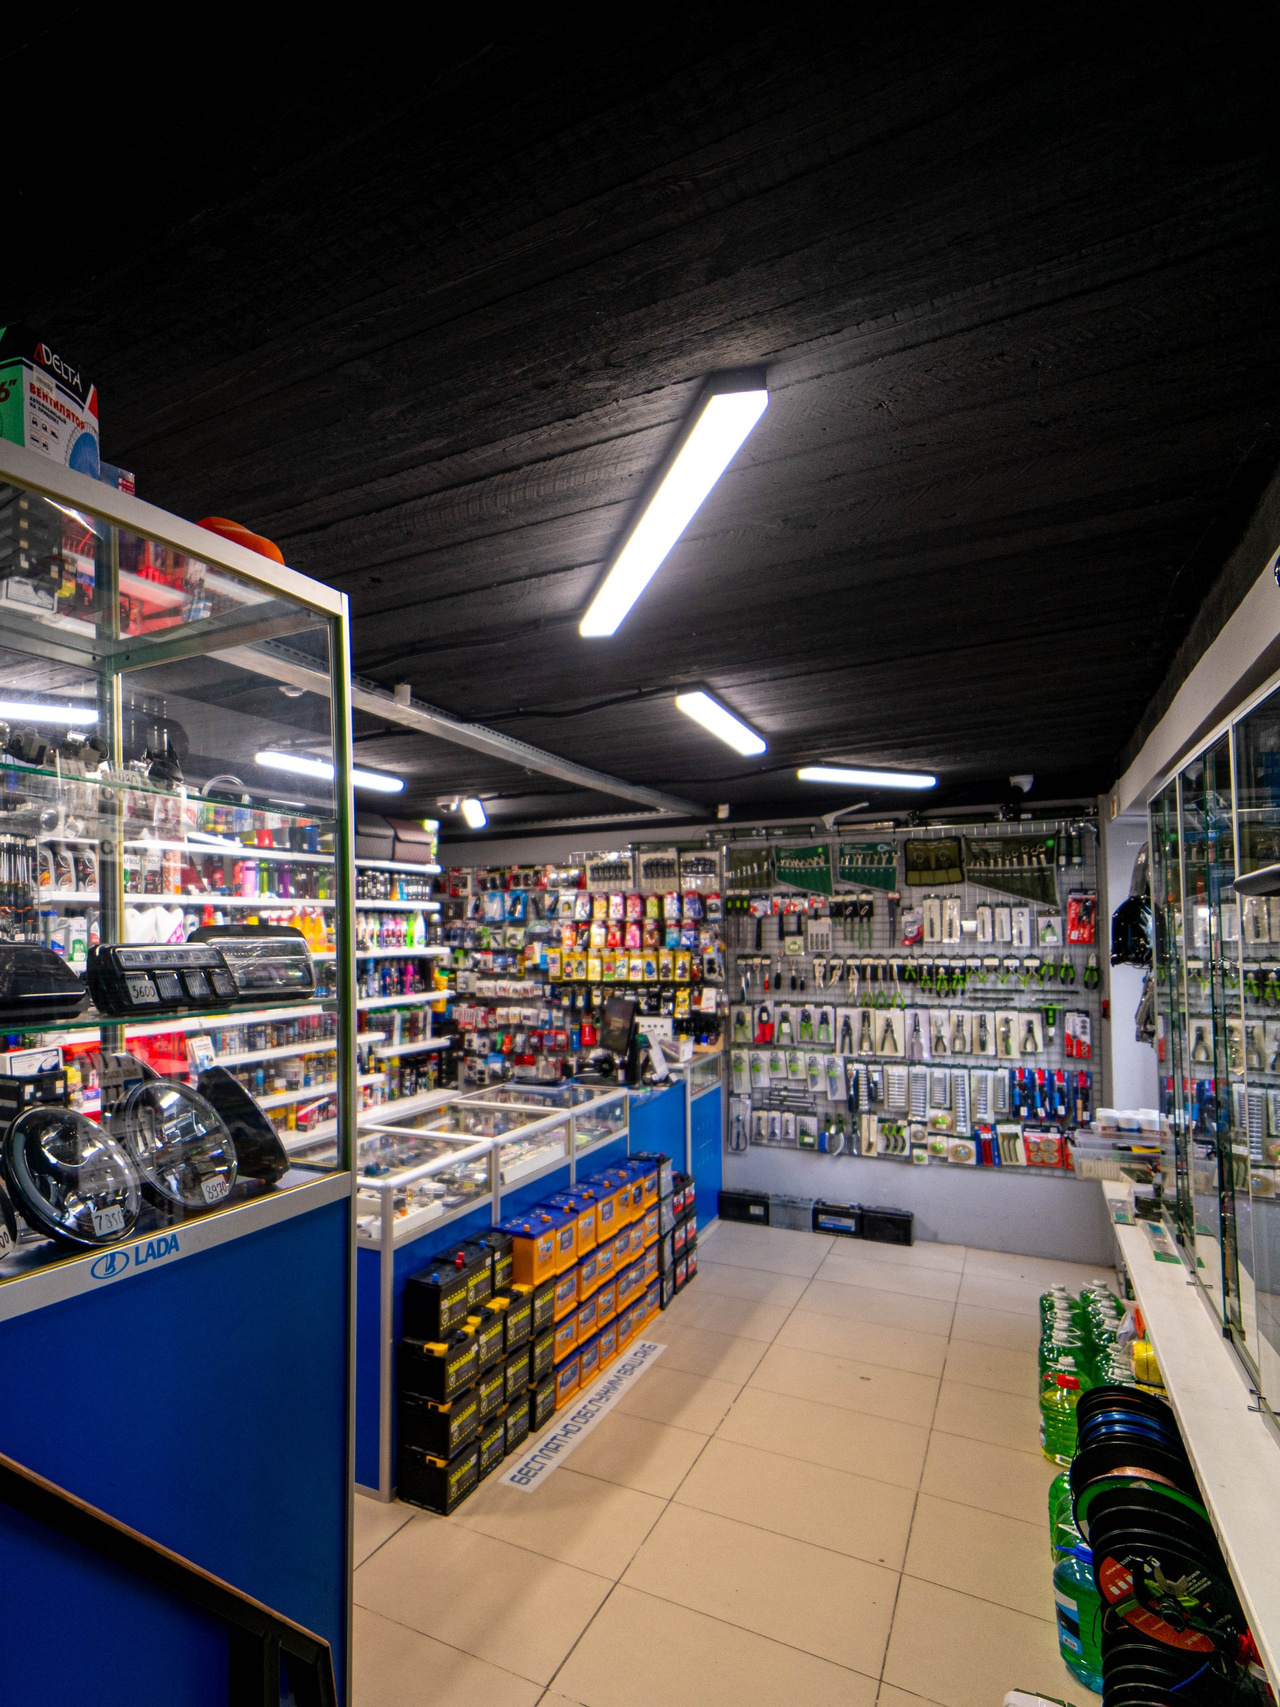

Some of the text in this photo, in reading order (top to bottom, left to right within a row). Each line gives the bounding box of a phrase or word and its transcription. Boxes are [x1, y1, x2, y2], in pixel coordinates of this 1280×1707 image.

[41, 342, 83, 393] DELTA
[29, 381, 85, 431] ВЕНТИЛЯТОР
[132, 983, 156, 999] 3600
[205, 1181, 228, 1200] 8970
[134, 1233, 180, 1267] LADA
[509, 1342, 658, 1486] БЕСПЛАТНО ОБСЛУЖИМ ВАШ АКБ
